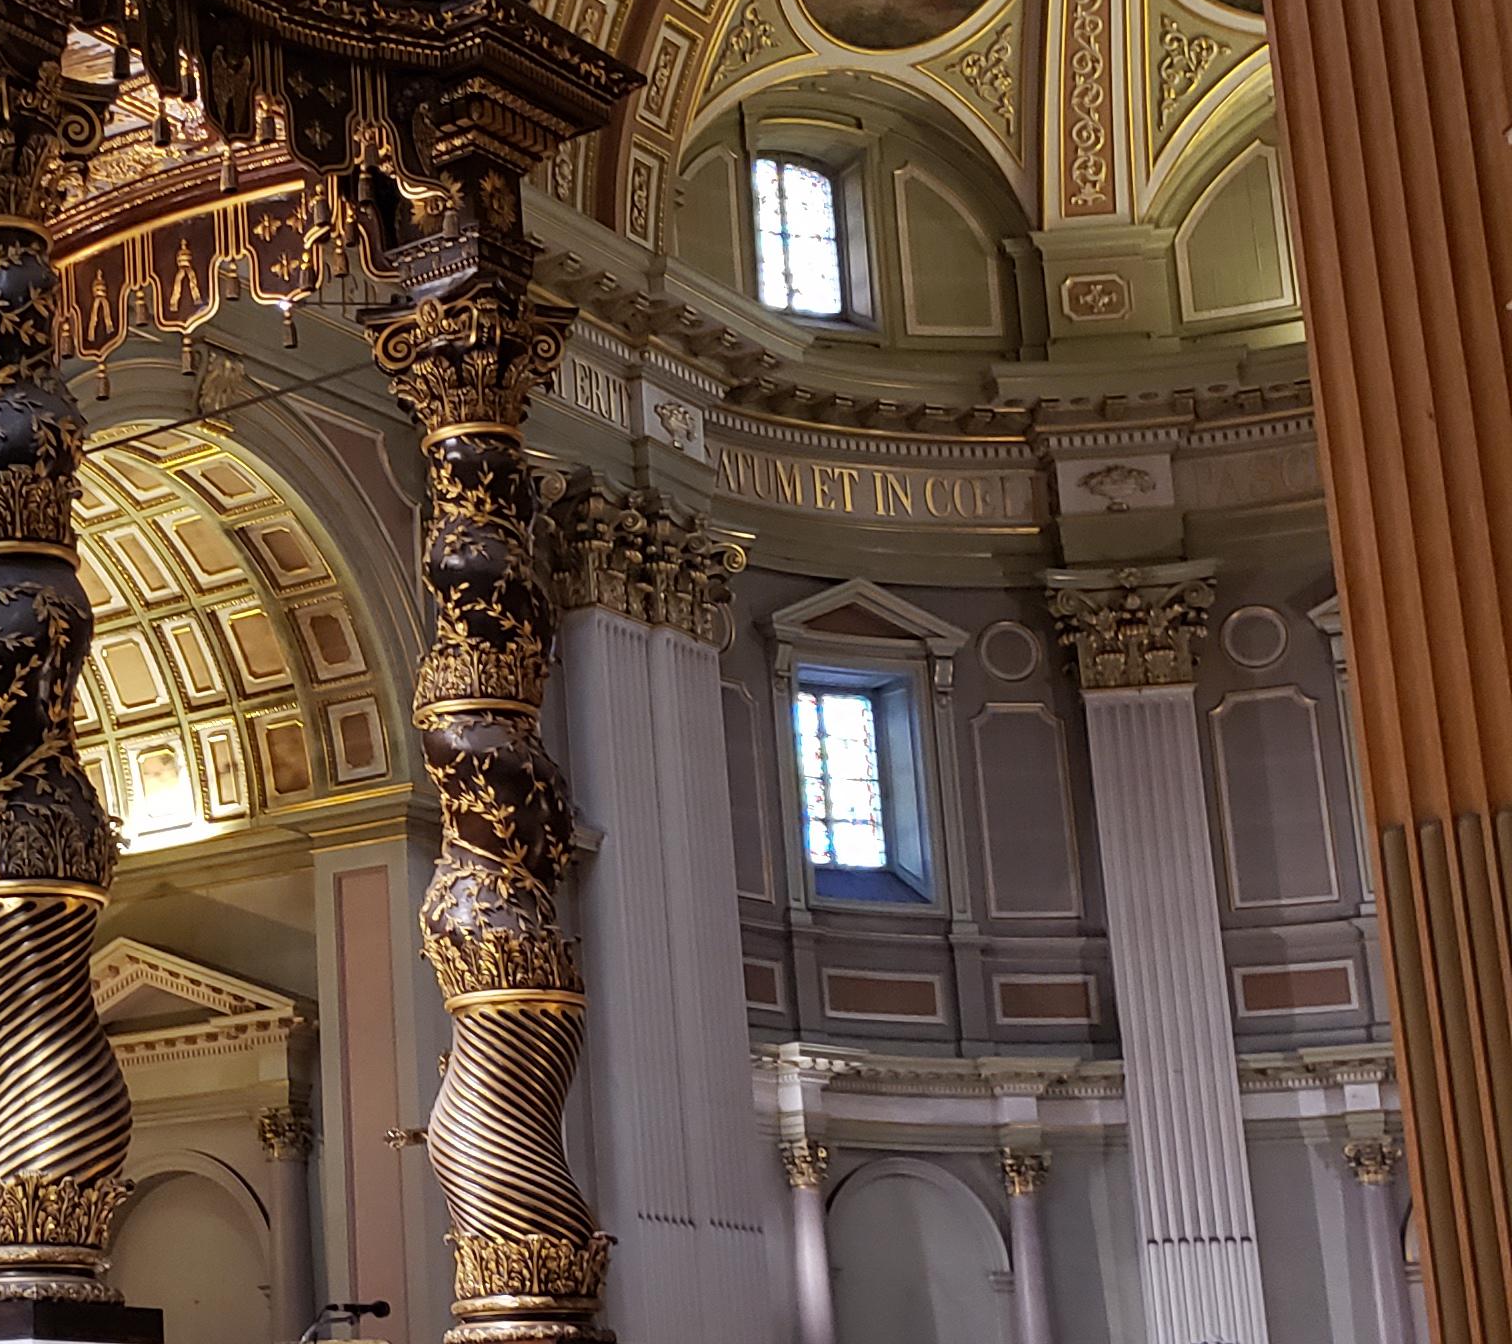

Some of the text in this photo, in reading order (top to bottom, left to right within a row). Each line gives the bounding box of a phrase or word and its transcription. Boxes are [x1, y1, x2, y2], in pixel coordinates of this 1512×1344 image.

[571, 357, 631, 430] ERIT
[810, 460, 861, 513] ET
[872, 470, 913, 518] IN
